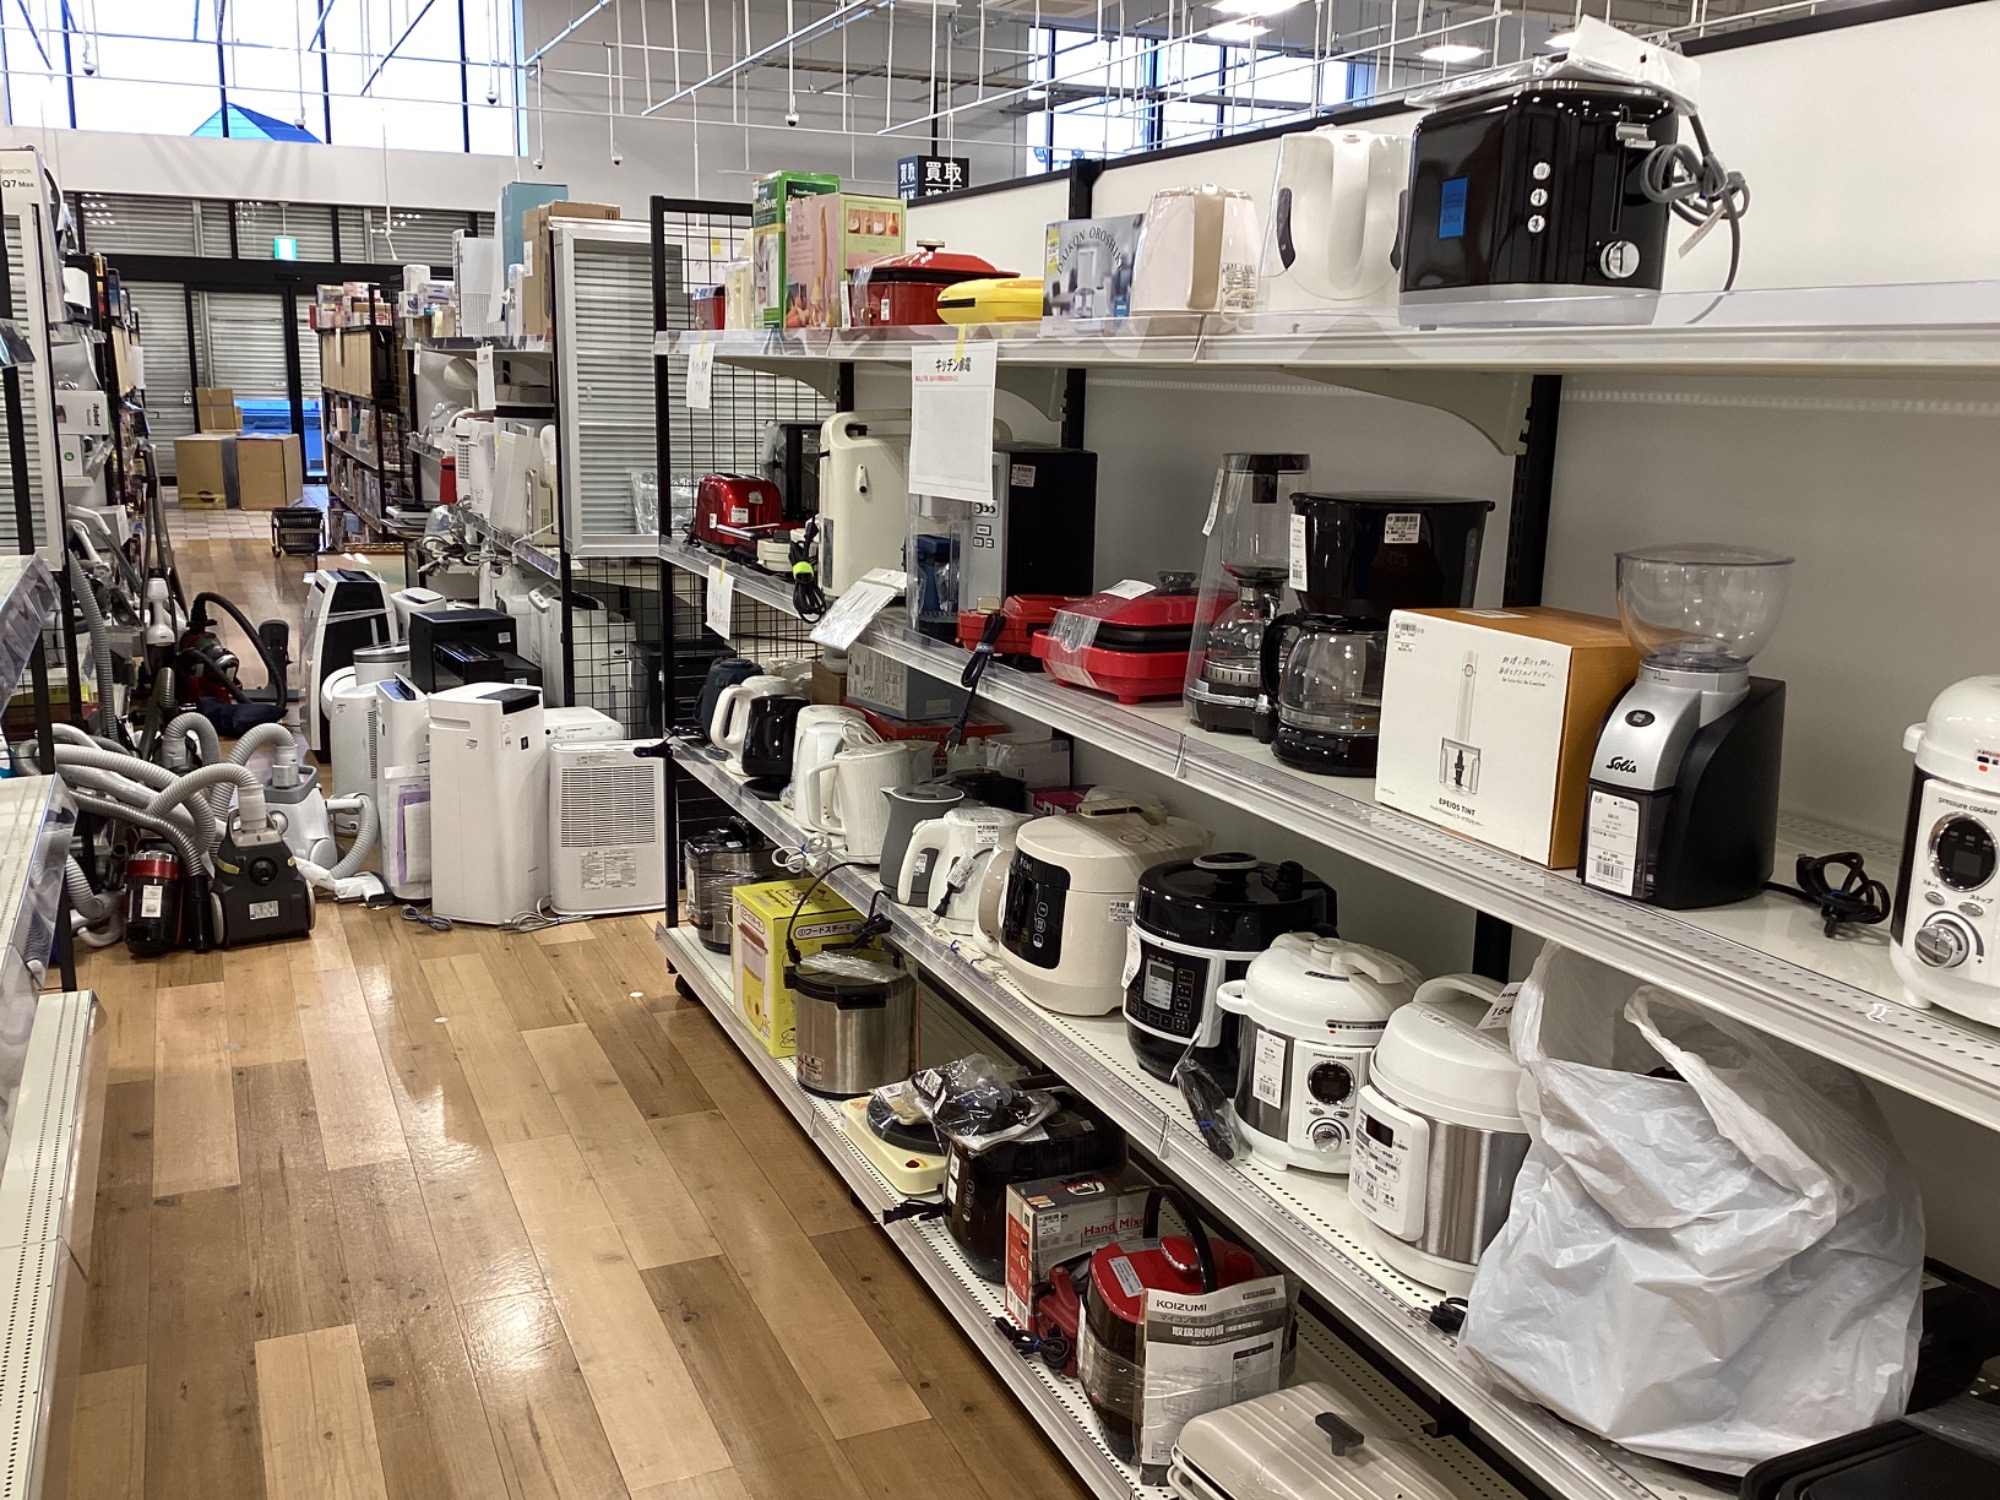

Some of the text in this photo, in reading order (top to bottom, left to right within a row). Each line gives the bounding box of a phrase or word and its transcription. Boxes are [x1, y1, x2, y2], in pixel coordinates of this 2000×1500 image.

[925, 161, 963, 182] 買取
[2, 179, 17, 188] Q7
[1605, 755, 1637, 773] Solis
[1438, 797, 1476, 817] EPEIOS TINT
[1938, 797, 1999, 816] pressure cooker
[1312, 1052, 1335, 1060] pressure
[1084, 1221, 1117, 1237] Hand
[1156, 1299, 1207, 1313] KOIZUMI
[1171, 1324, 1225, 1338] 取扱説明書
